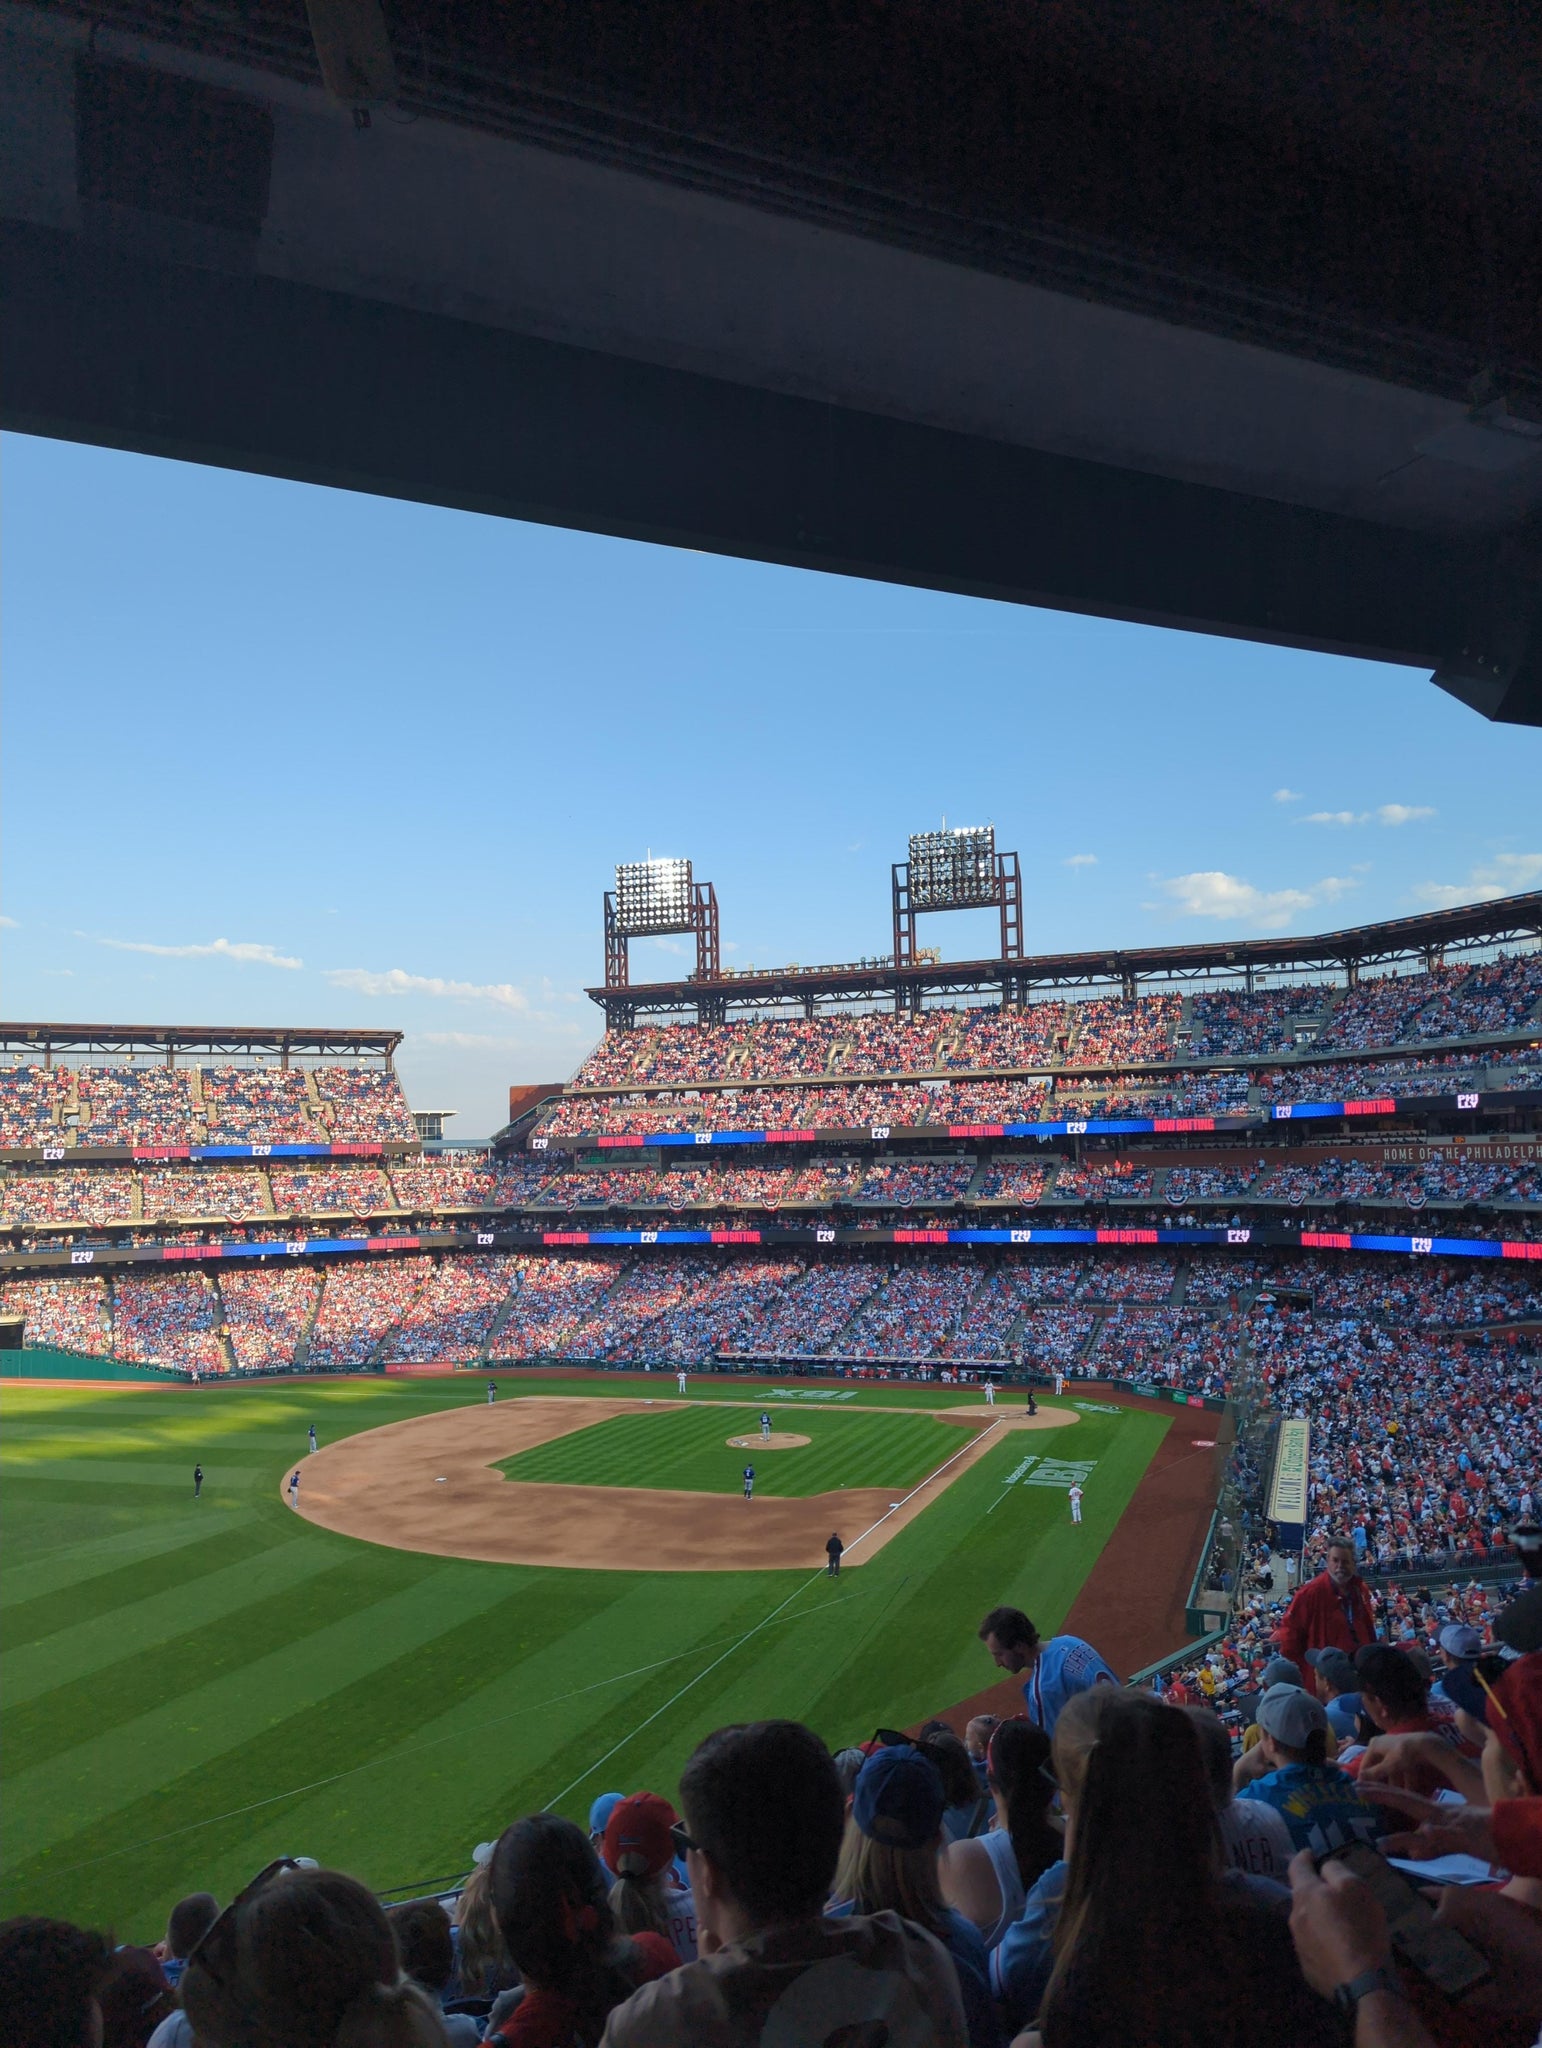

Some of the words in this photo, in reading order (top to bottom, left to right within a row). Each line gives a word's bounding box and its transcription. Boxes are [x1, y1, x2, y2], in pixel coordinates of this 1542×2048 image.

[1344, 1101, 1362, 1114] NOW
[1363, 1099, 1396, 1113] BATTING
[950, 1125, 969, 1137] NOW
[970, 1125, 1003, 1136] BATTING
[1154, 1120, 1175, 1132] NOW
[1176, 1118, 1214, 1131] BATTING
[766, 1131, 783, 1141] NOW
[784, 1130, 815, 1141] BATTING
[1384, 1148, 1413, 1160] HOME
[1419, 1147, 1432, 1160] OF
[1467, 1145, 1542, 1158] PHILADELPH
[711, 1231, 729, 1242] NOW
[730, 1231, 760, 1242] BATTING
[894, 1231, 913, 1242] NOW
[914, 1231, 948, 1242] BATTING
[1097, 1230, 1119, 1242] NOW
[1120, 1230, 1157, 1242] BATTING
[1302, 1233, 1319, 1246] NOW
[1320, 1233, 1351, 1248] BATTING
[1502, 1242, 1525, 1258] NOW
[1023, 1457, 1099, 1488] IBX
[1276, 1477, 1302, 1509] WELCOME
[1227, 1838, 1274, 1874] NER
